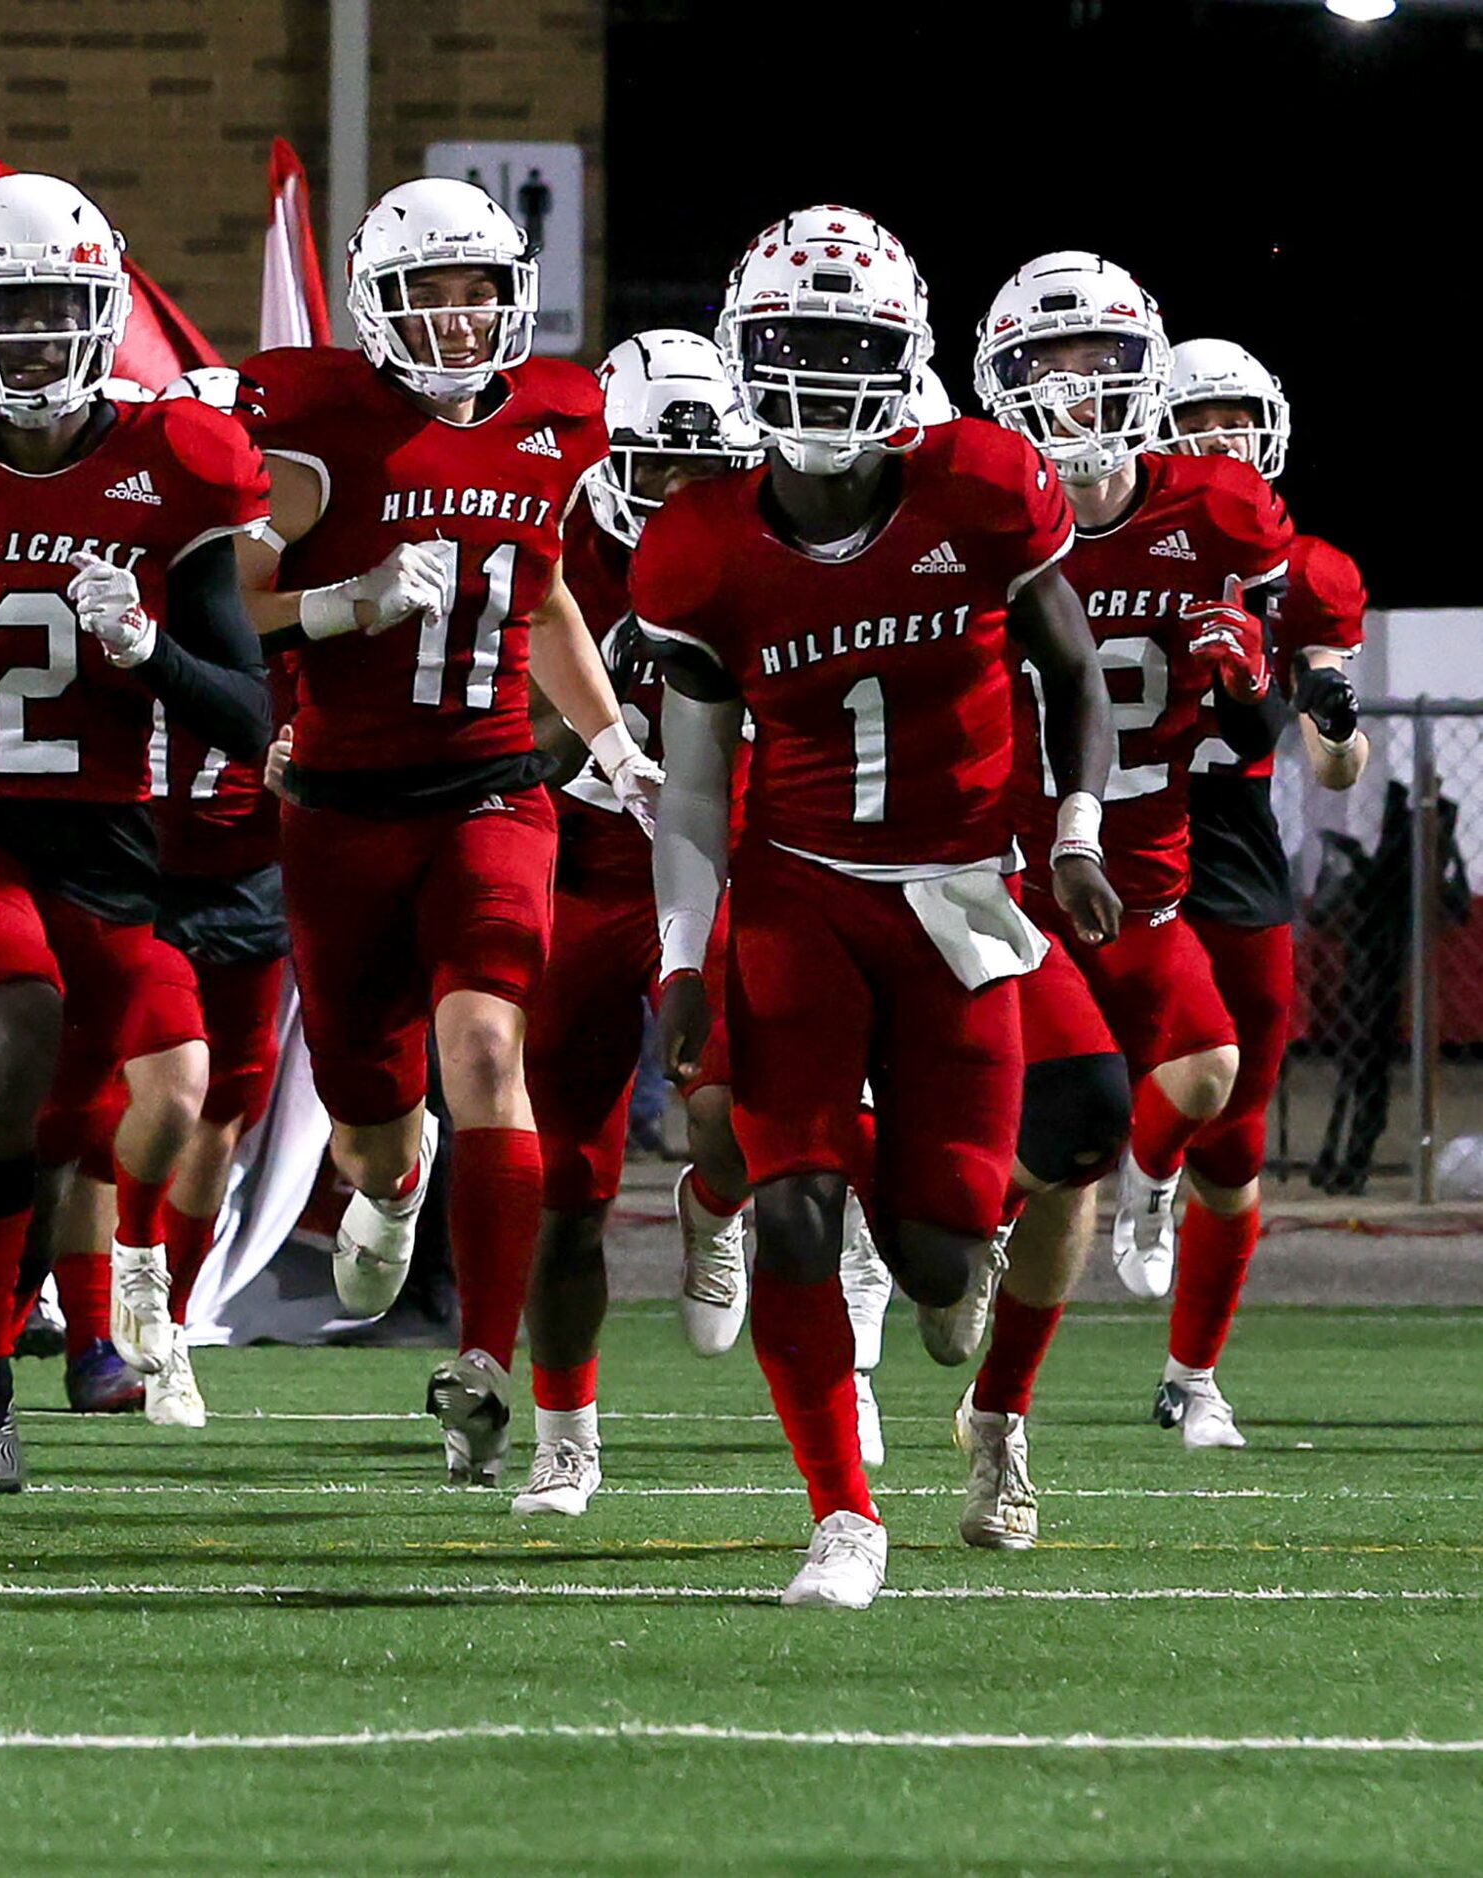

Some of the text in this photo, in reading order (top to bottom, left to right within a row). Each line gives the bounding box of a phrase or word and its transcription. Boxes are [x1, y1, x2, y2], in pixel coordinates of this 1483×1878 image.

[517, 441, 562, 459] adidas
[104, 488, 162, 505] adidas
[381, 488, 552, 526] HILLCREST
[1149, 545, 1197, 561] adidas
[911, 562, 967, 574] adidas
[413, 541, 517, 709] 11
[761, 604, 970, 675] HILLCREST
[842, 675, 887, 823] 1
